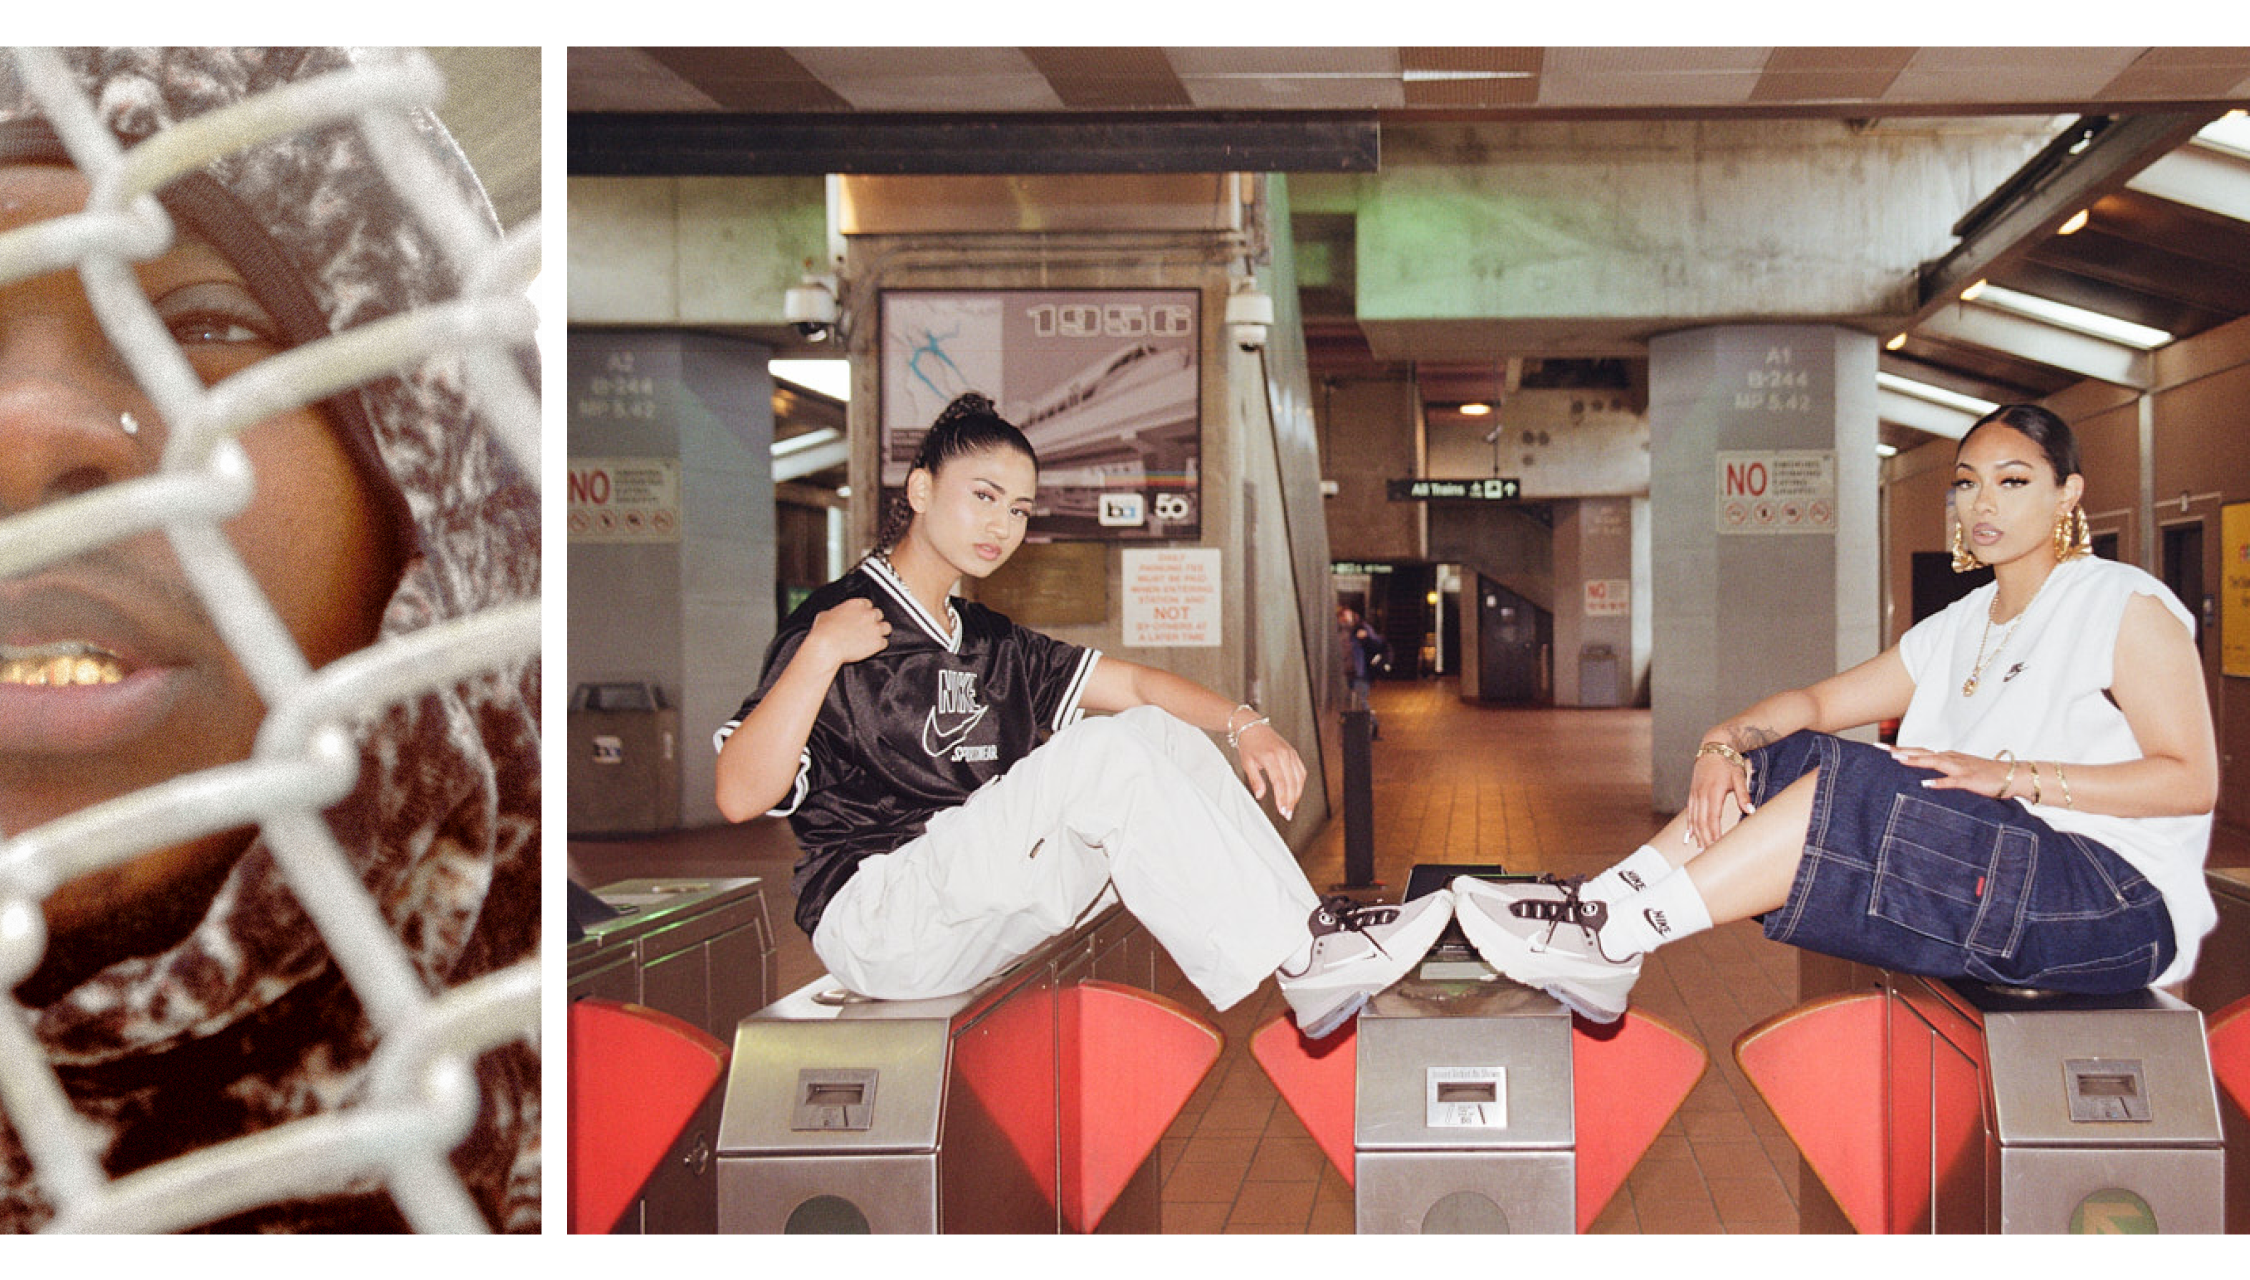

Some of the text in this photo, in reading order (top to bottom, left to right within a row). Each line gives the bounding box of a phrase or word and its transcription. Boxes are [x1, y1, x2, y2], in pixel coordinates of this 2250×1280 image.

[1027, 304, 1191, 337] 1956
[568, 469, 611, 505] NO
[1411, 482, 1466, 497] All Trains
[1726, 462, 1768, 497] NO
[1153, 606, 1190, 619] NOT
[938, 669, 981, 714] NIKE
